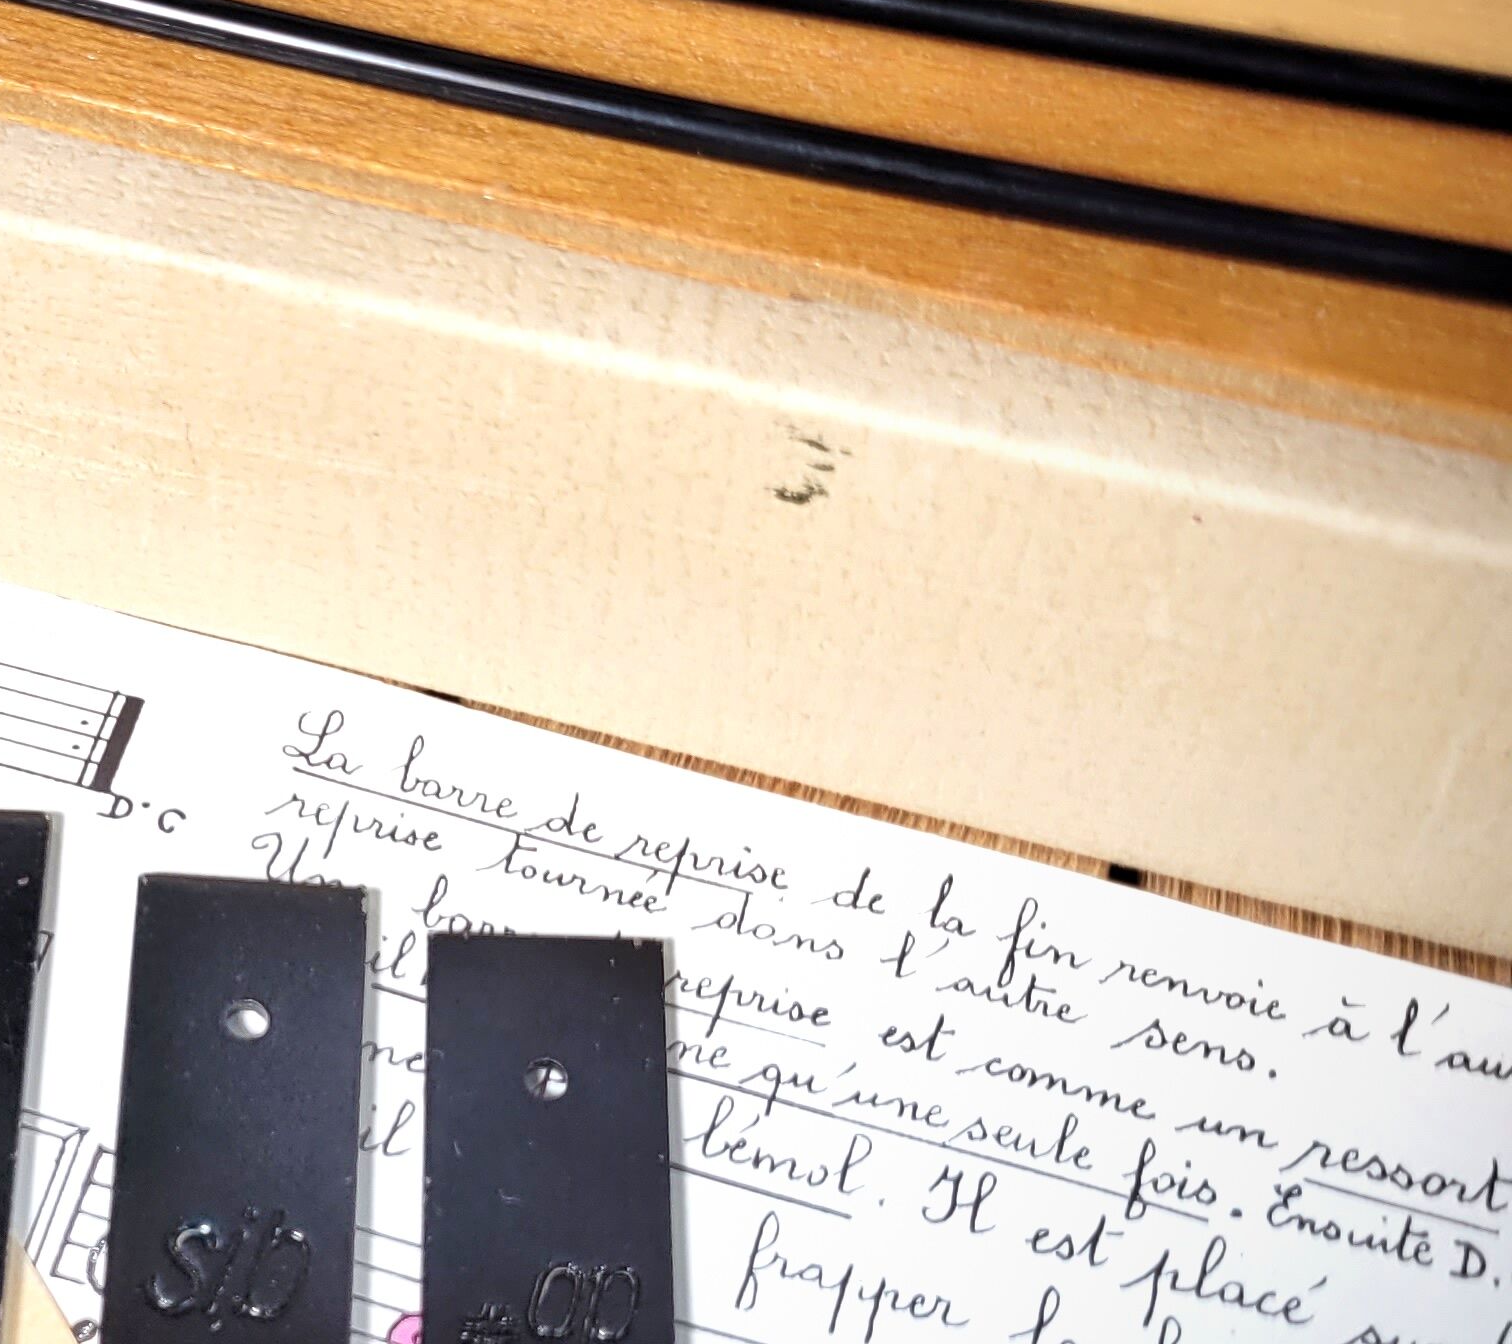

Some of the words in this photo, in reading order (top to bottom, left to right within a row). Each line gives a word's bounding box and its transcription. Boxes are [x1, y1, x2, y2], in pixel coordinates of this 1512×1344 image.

[264, 792, 443, 859] reprise
[475, 832, 668, 914] tournée
[691, 892, 845, 962] dans
[1111, 1015, 1278, 1081] sens.
[282, 709, 364, 775] La
[397, 737, 517, 819] barre
[524, 793, 603, 843] de
[614, 834, 788, 896] reprise
[812, 868, 886, 915] de
[925, 874, 976, 938] la
[997, 899, 1092, 987] fin
[1099, 959, 1287, 1021] renvoie
[1301, 996, 1370, 1040] à
[664, 966, 833, 1037] reprise
[881, 1017, 957, 1061] est
[955, 1058, 1156, 1121] comme
[1175, 1106, 1280, 1151] un
[1280, 1140, 1512, 1212] ressort
[946, 1119, 1093, 1172] seule
[1122, 1139, 1244, 1221] fois.
[1025, 1217, 1126, 1265] est
[1118, 1240, 1327, 1328] placé
